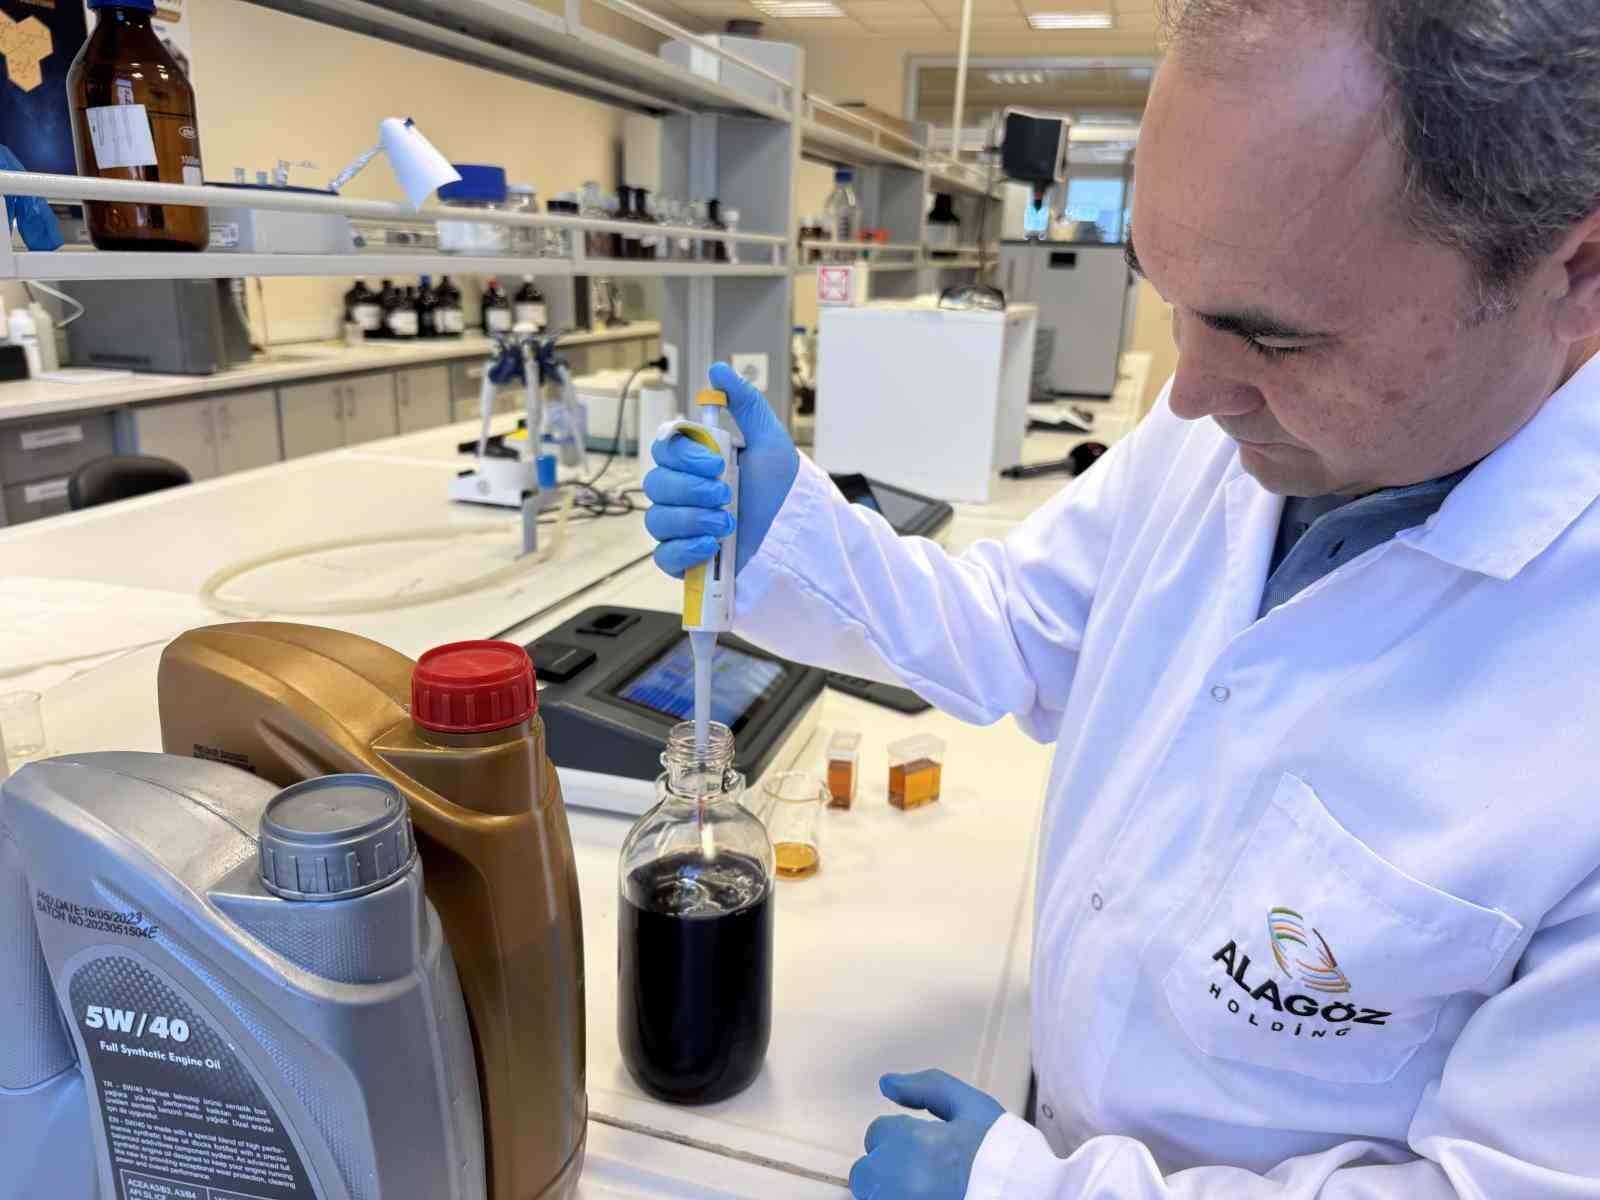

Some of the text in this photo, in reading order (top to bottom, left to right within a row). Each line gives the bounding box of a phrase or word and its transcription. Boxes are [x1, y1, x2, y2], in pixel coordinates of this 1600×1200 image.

[1212, 940, 1392, 1026] ALAGÖZ
[85, 1004, 191, 1044] 5W/40
[100, 1041, 222, 1070] Full Synthetic Engine Oil
